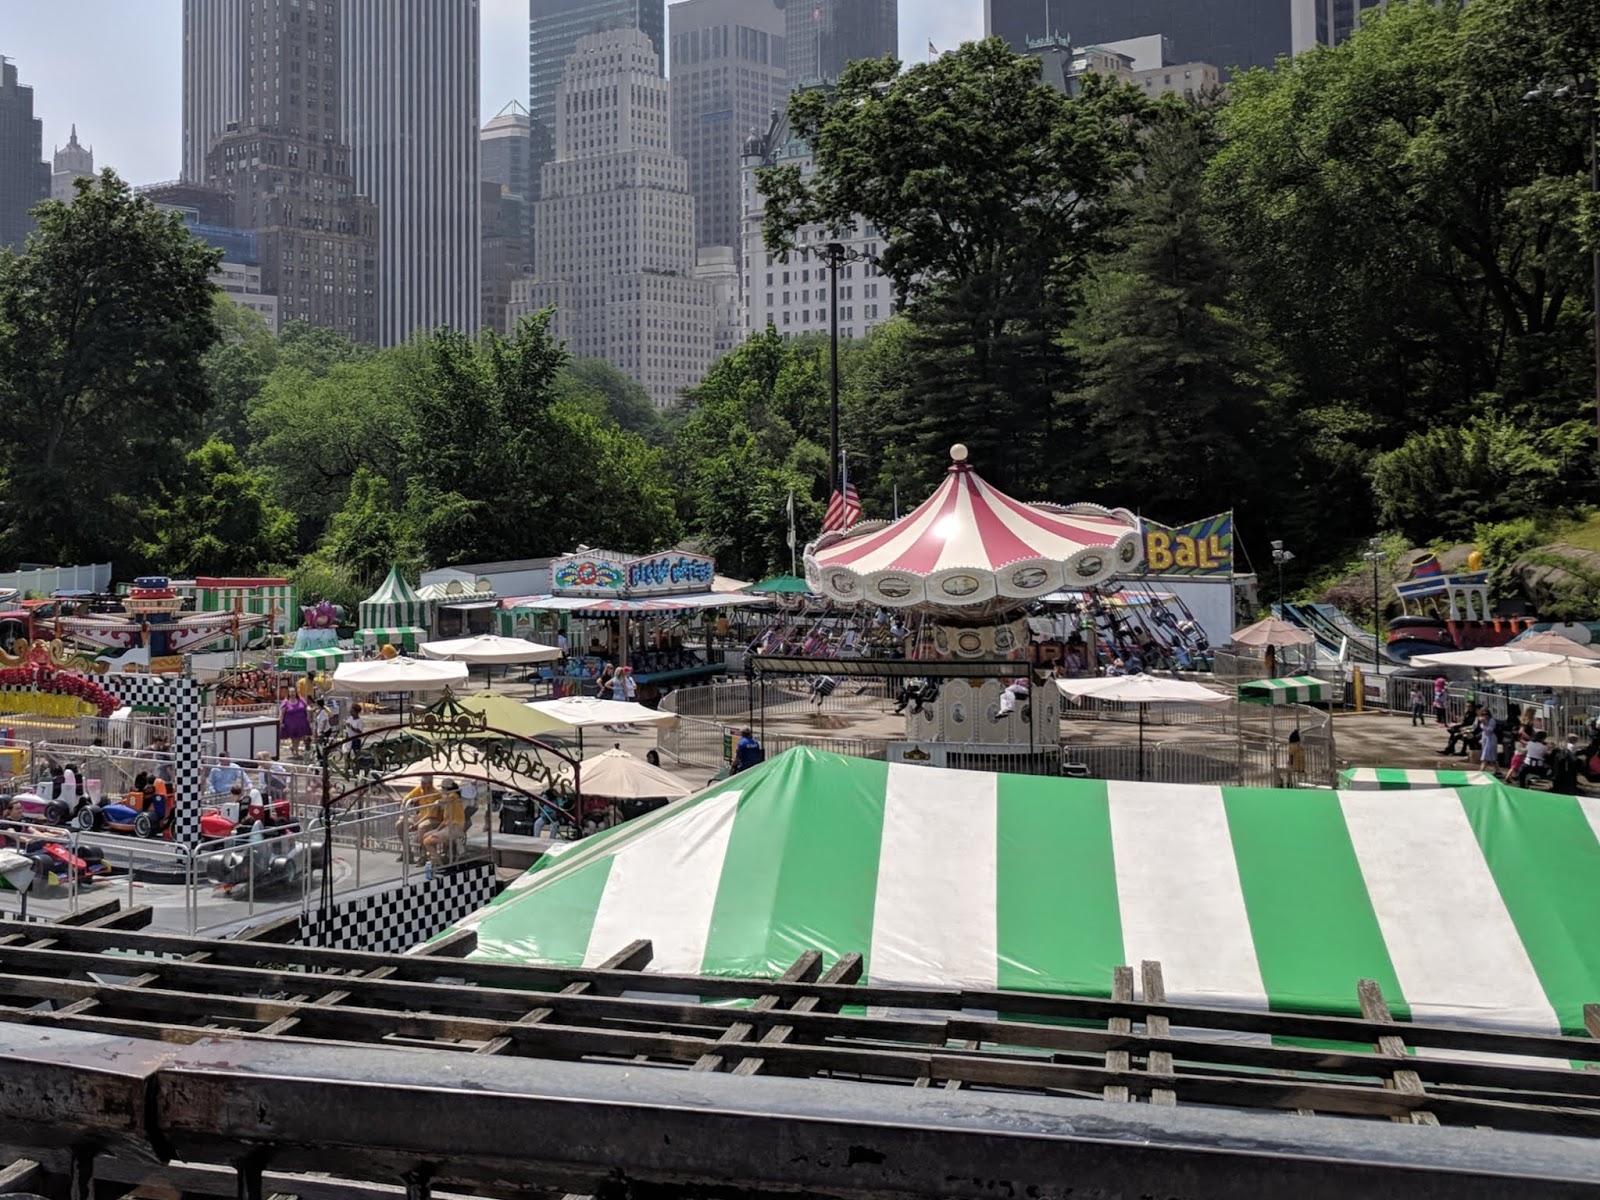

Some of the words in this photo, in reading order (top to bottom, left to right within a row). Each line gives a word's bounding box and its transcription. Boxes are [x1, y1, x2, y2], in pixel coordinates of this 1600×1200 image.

[458, 742, 573, 797] GARDENS
[40, 786, 46, 795] 7
[129, 796, 136, 806] 8
